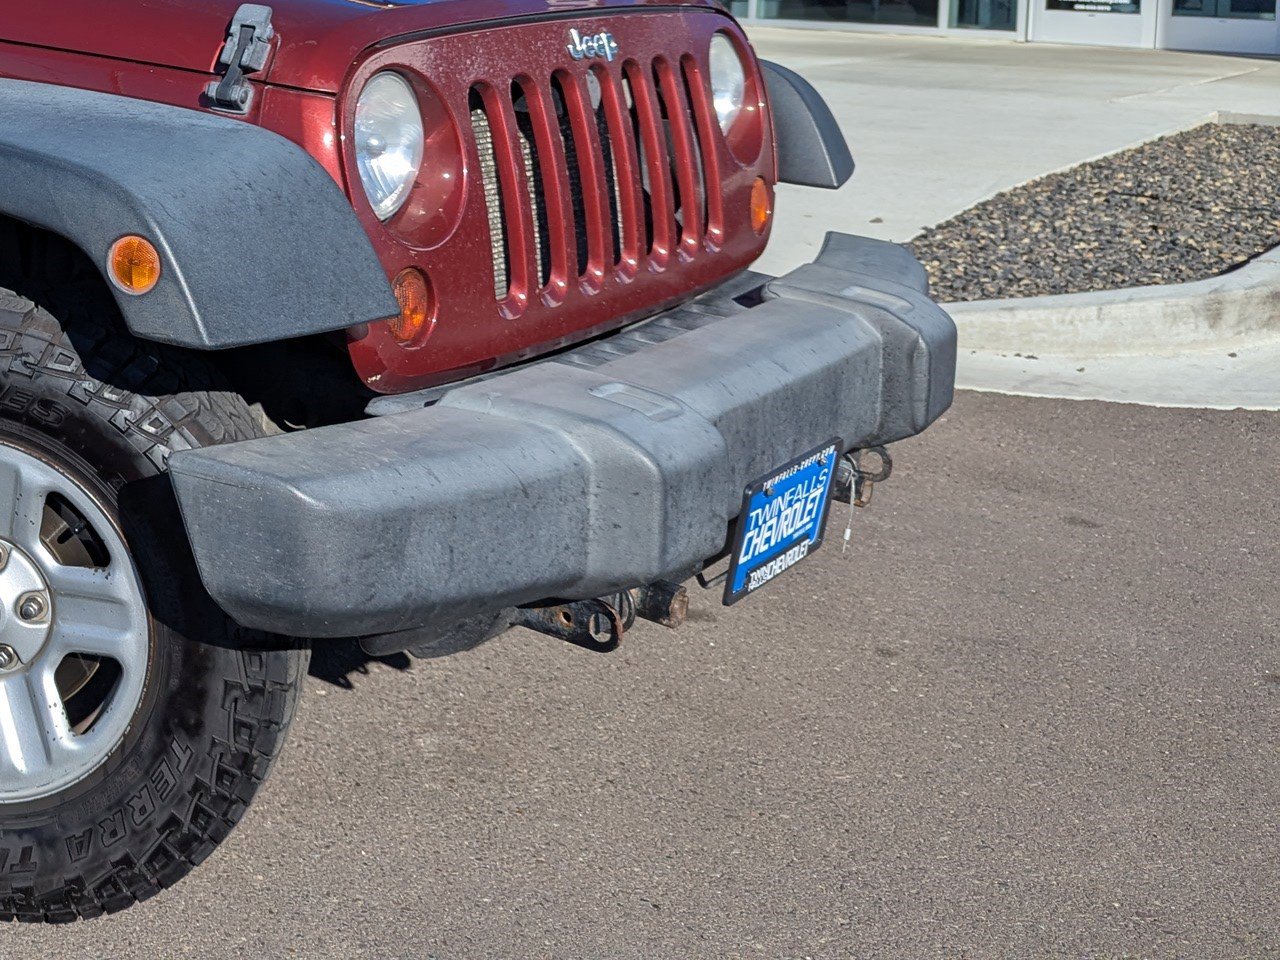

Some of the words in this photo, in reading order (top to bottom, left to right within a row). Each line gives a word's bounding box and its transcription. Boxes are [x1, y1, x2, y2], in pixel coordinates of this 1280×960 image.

[566, 28, 618, 62] Jeep
[738, 486, 824, 565] CHEVROLET
[767, 539, 811, 580] CHEVROLET
[63, 734, 194, 865] TERRA
